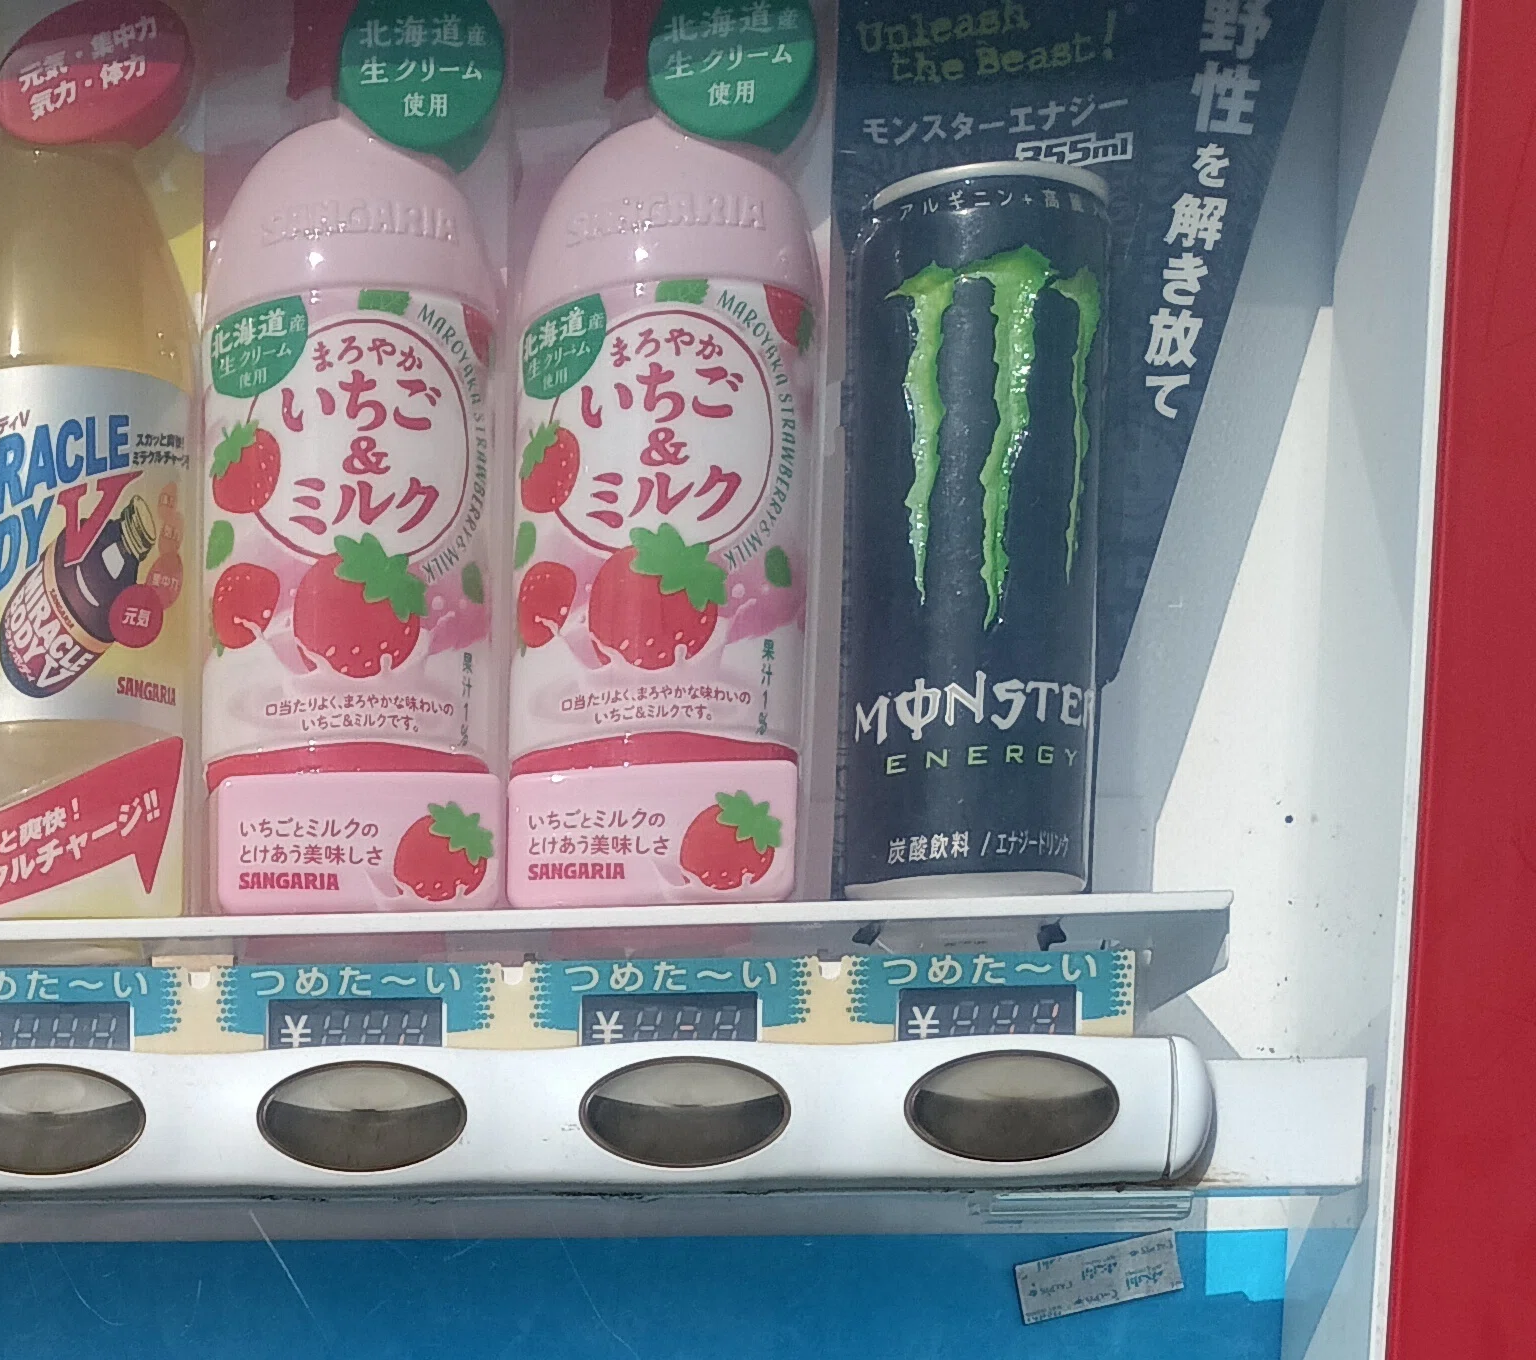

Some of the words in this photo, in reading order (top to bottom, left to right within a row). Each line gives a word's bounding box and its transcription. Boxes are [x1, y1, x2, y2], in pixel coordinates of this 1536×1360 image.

[359, 15, 486, 49] 北海道産
[361, 57, 483, 84] 生クリーム
[665, 44, 793, 81] 生クリーム
[891, 47, 964, 84] the
[402, 93, 448, 118] 使用
[707, 80, 755, 107] 使用
[863, 95, 1129, 146] モンスターエナジー
[1145, 0, 1271, 420] 野性を解き放て
[313, 336, 424, 373] まろやか
[281, 371, 442, 433] いちご
[581, 362, 743, 429] いちご
[639, 427, 690, 467] &
[290, 479, 439, 536] ミルク
[585, 464, 742, 532] ミルク
[122, 607, 151, 628] 元気
[886, 744, 1080, 775] ENERGY
[239, 819, 380, 842] いちごとミルクの
[528, 808, 666, 832] いちごとミルクの
[239, 843, 384, 867] とけあう美味しさ
[528, 834, 671, 857] とけあう美味しさ
[239, 871, 339, 891] SANGARIA
[528, 861, 625, 882] SANGARIA
